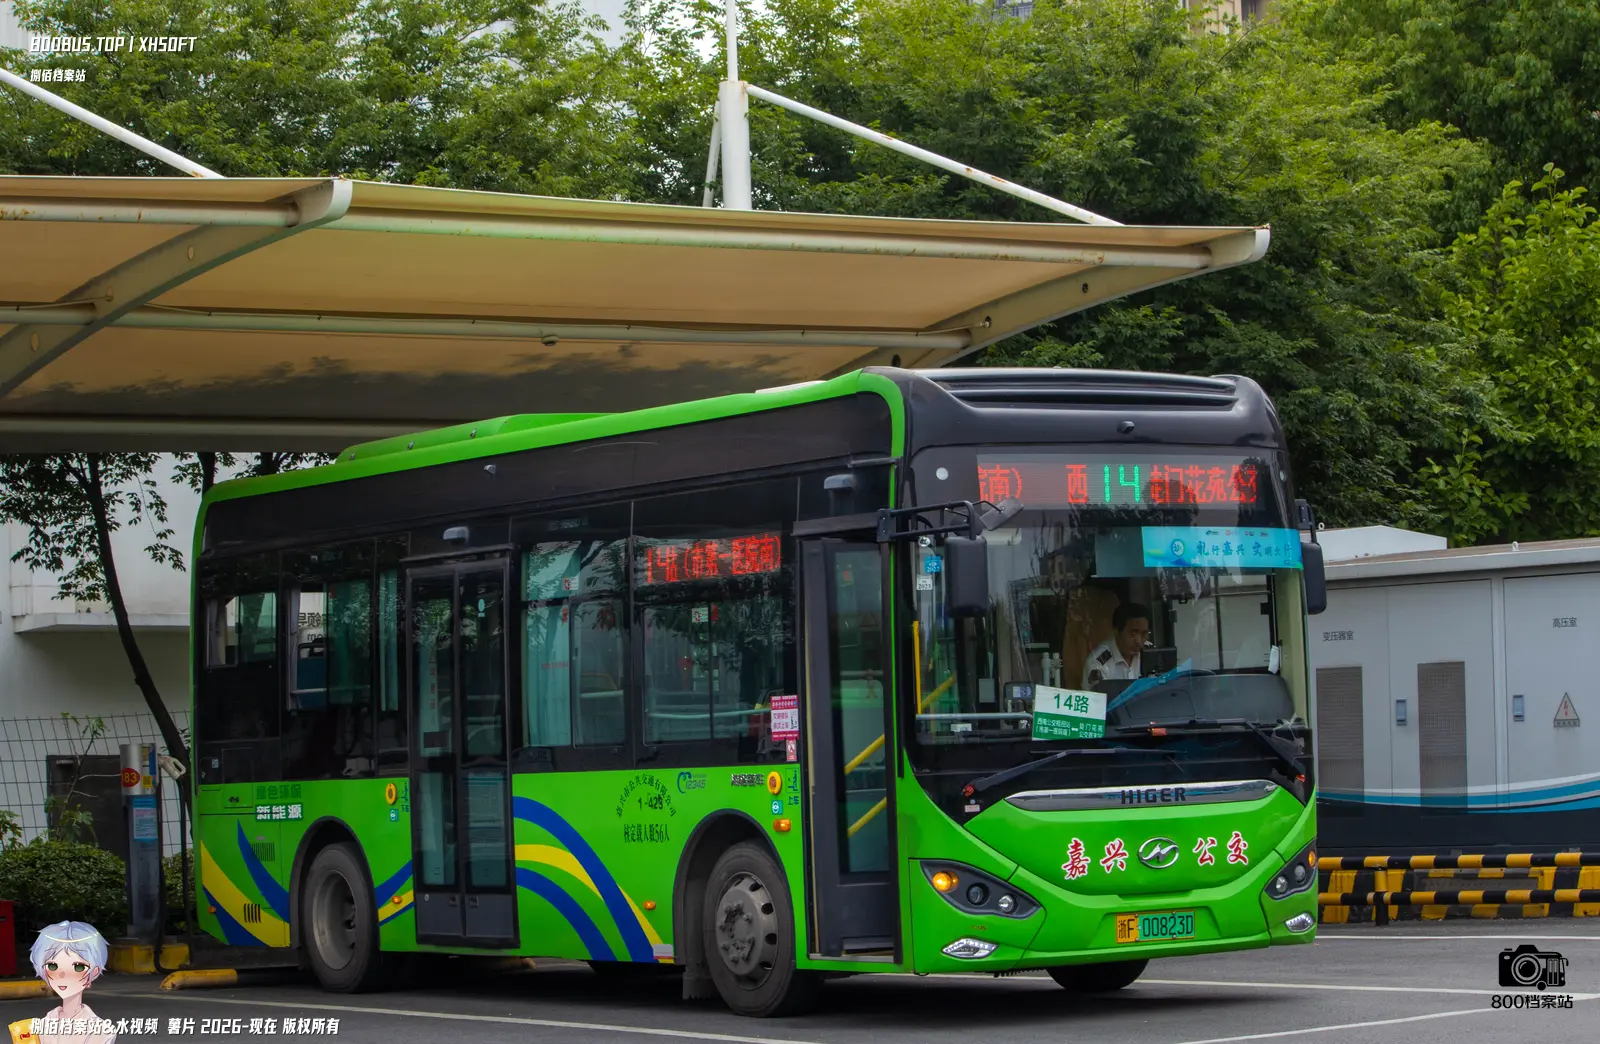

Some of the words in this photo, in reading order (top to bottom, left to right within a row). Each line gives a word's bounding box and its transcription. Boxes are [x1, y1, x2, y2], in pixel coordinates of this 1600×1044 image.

[1066, 464, 1087, 503] 西
[1104, 464, 1140, 503] 14
[1553, 617, 1578, 628] 高压室
[1322, 631, 1354, 642] 变压器室
[1054, 693, 1089, 713] 14路
[1121, 787, 1186, 805] HIGER
[256, 804, 302, 819] 新能源
[1062, 837, 1129, 880] 嘉兴
[1192, 831, 1249, 866] 公交
